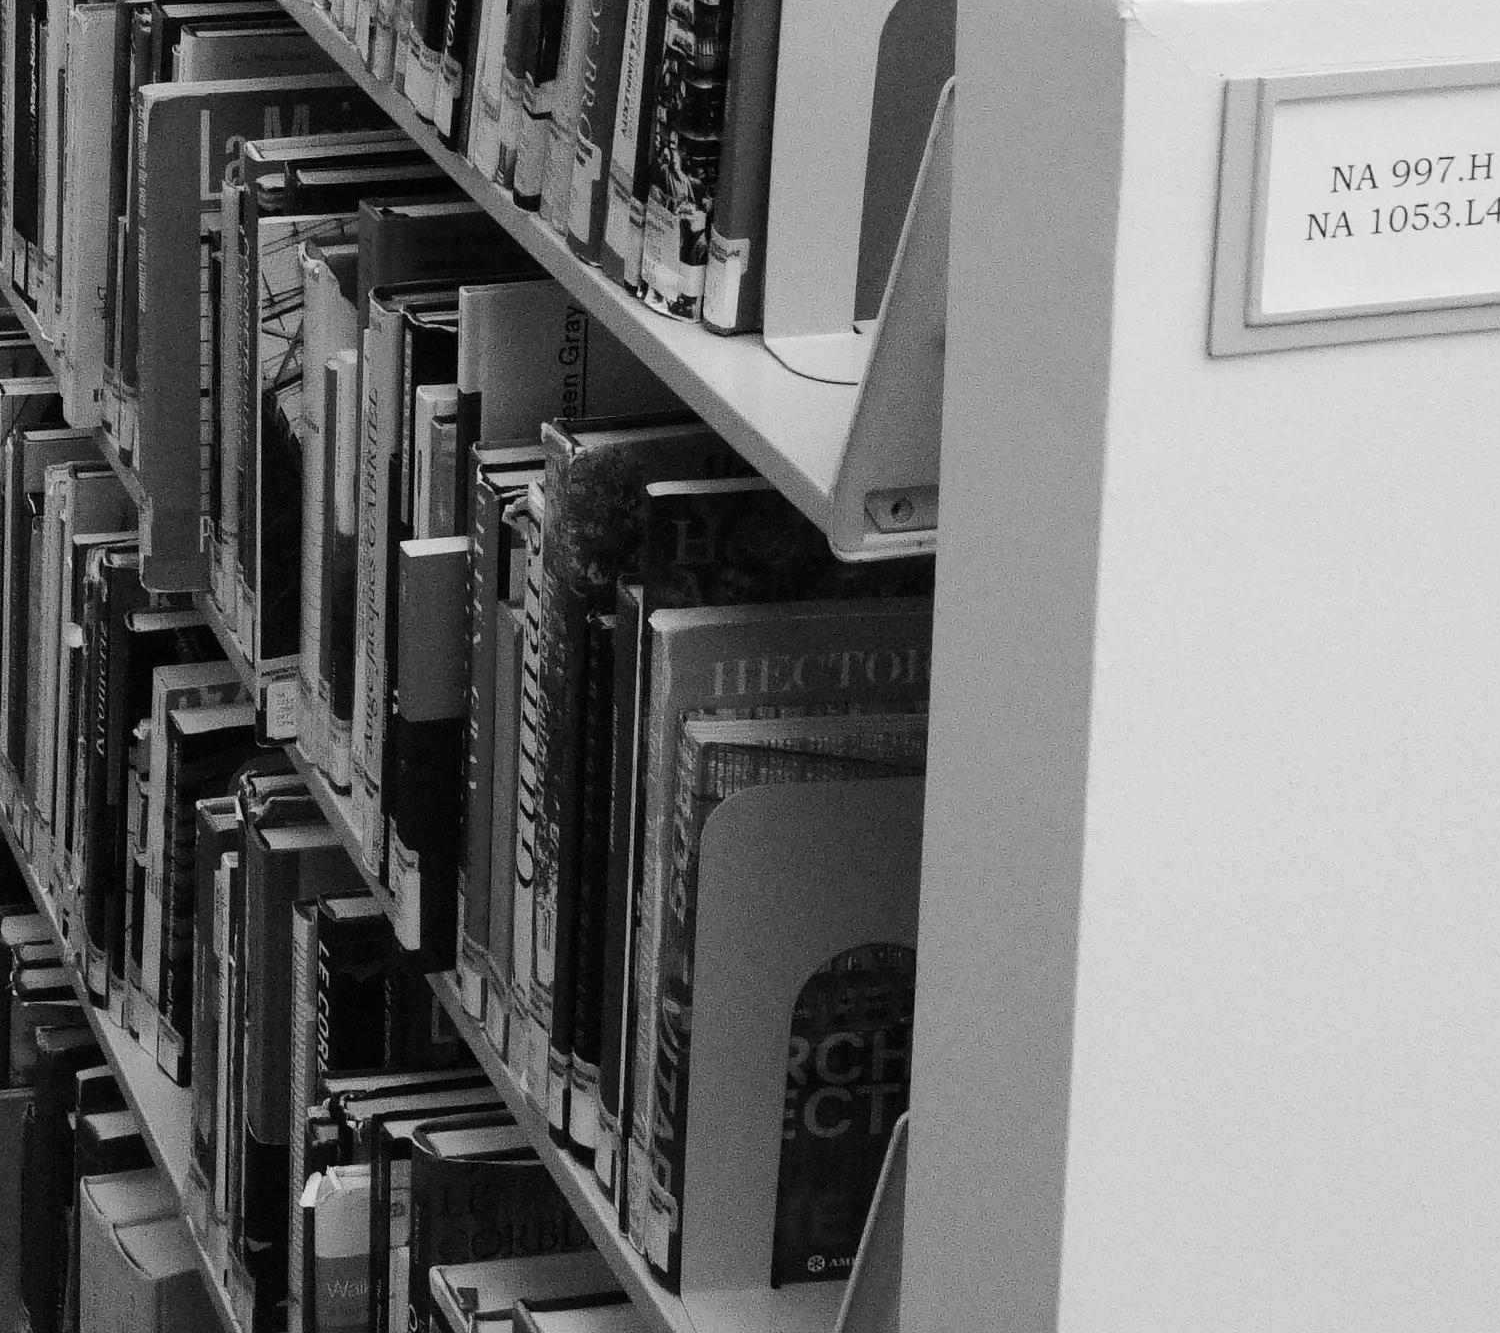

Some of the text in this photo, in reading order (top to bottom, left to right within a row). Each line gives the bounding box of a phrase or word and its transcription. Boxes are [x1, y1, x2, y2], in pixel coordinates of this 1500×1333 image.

[1330, 163, 1379, 193] NA
[1391, 152, 1494, 188] 997.H
[1305, 210, 1355, 241] NA
[557, 305, 585, 419] een Gray
[363, 386, 379, 548] GABRIEL
[318, 939, 330, 989] LE
